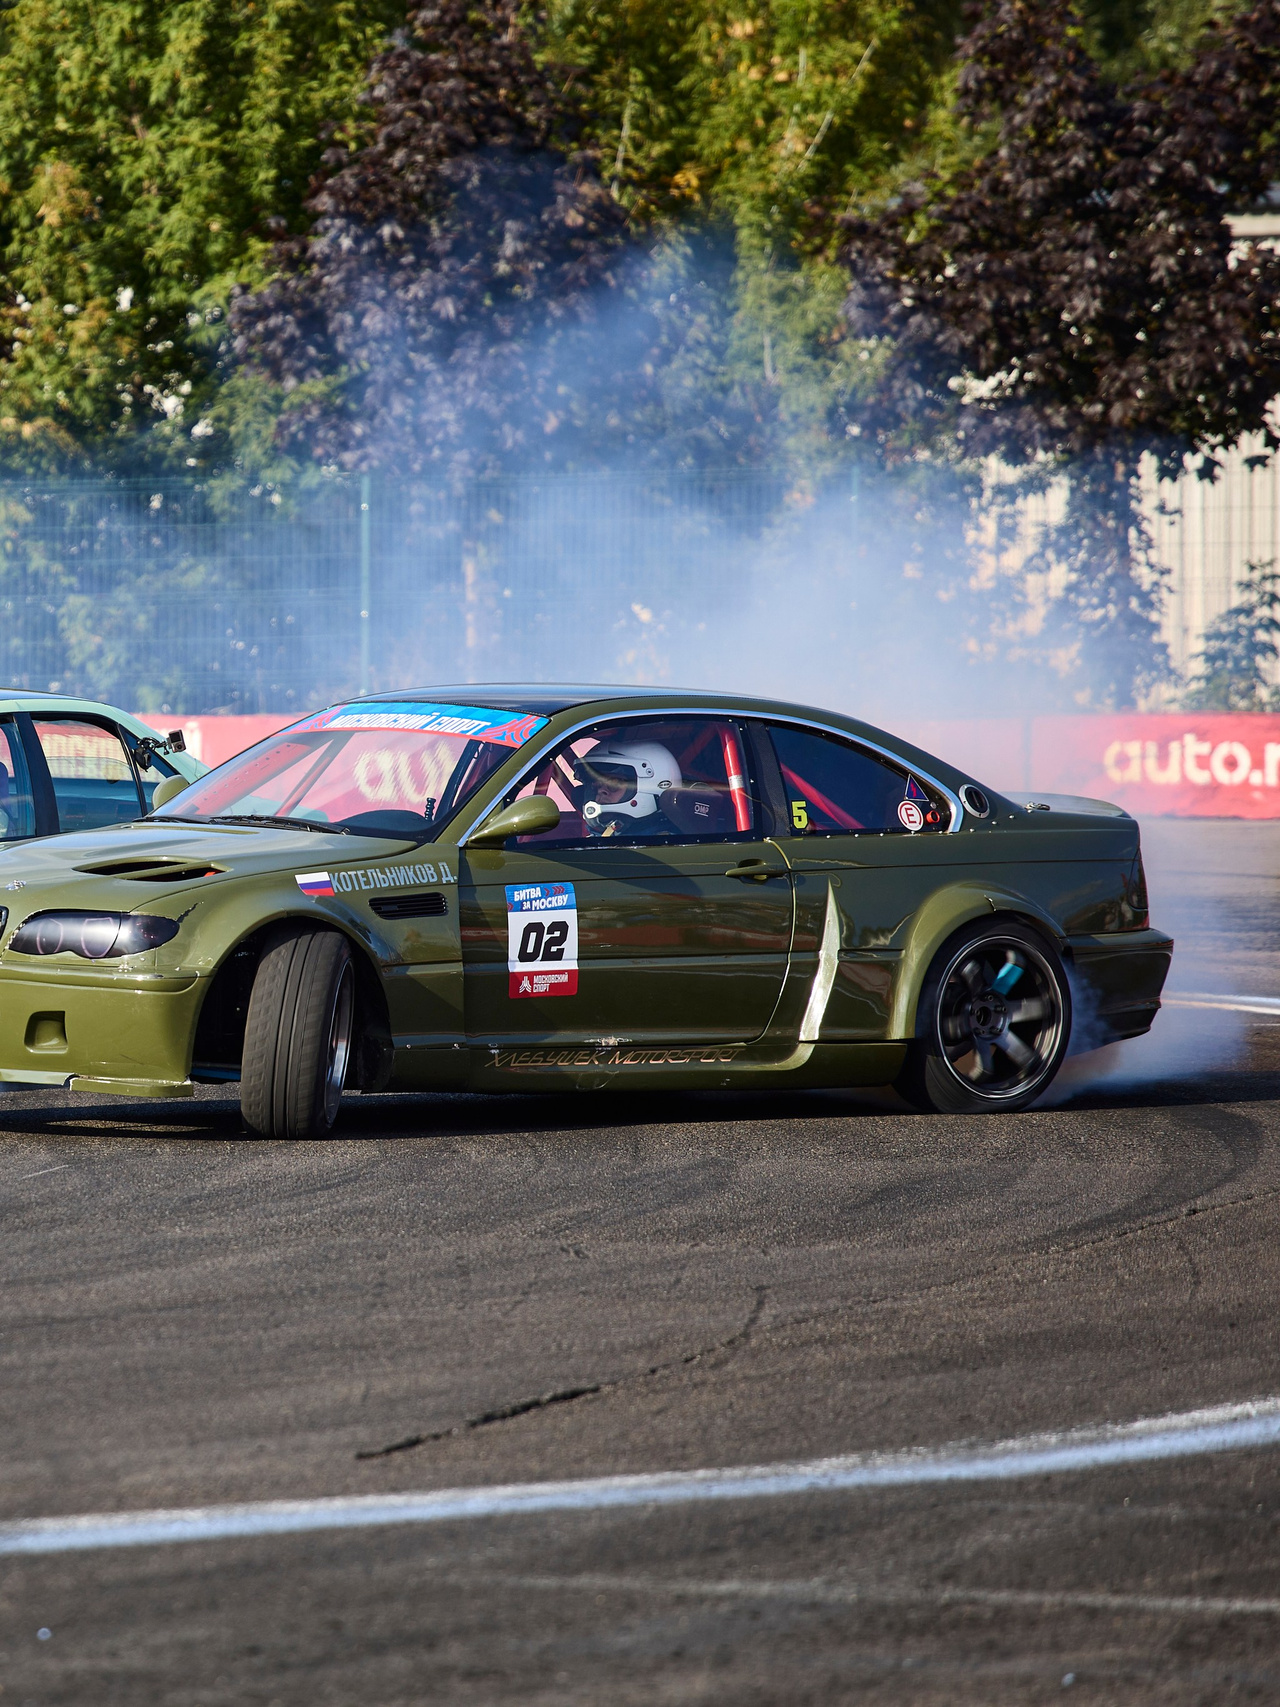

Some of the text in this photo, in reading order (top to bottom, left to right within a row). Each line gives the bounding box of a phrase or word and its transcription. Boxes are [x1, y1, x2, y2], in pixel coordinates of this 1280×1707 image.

[322, 712, 490, 736] МОСКОВСКИЙ СПОРТ
[694, 804, 709, 814] OMP
[792, 801, 808, 829] 5
[905, 807, 917, 824] E
[329, 862, 458, 893] КОТЕЛЬНИКОВ Д.
[514, 887, 542, 901] БИТВА
[523, 894, 568, 911] ЗА МОСКВУ
[518, 921, 569, 962] 02
[533, 972, 569, 984] МОСКОВСКИЙ
[533, 984, 550, 993] СПОРТ
[608, 1049, 742, 1065] MOTORSPORT
